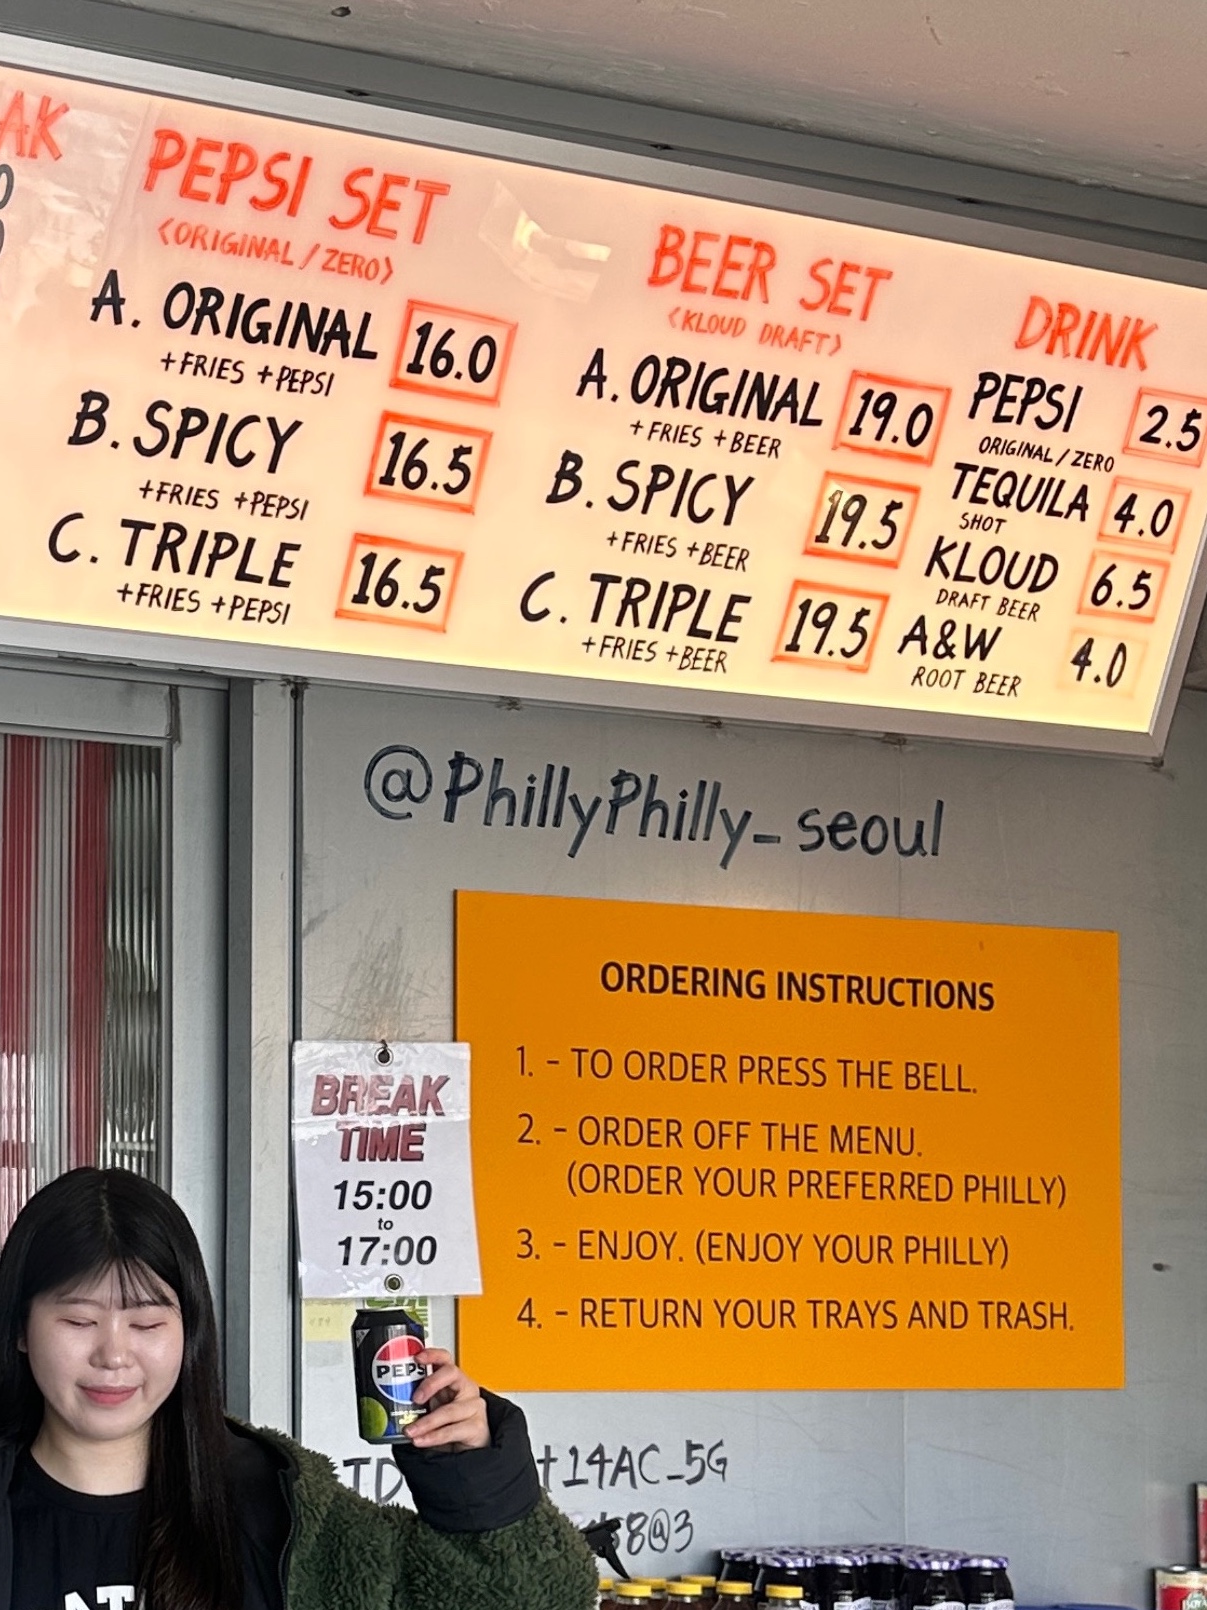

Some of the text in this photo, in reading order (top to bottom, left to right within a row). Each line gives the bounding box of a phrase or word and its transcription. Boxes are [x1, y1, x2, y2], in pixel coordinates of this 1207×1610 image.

[144, 128, 450, 245] PEPSI SET
[648, 224, 893, 322] BEER SET
[163, 282, 379, 361] ORIGINAL
[407, 321, 497, 385] 16.0
[1015, 296, 1158, 372] DRINK
[848, 388, 934, 447] 19.0
[969, 372, 1202, 453] PEPSI 2.5
[379, 431, 472, 496] 16.5
[608, 459, 755, 526] SPICY
[814, 489, 905, 550] 19.5
[953, 462, 1175, 539] TEQUILA 4.0
[960, 512, 1005, 535] SHOT
[120, 518, 301, 588] TRIPLE
[352, 551, 444, 615] 16.5
[926, 536, 1152, 610] KLOUD 6.5
[590, 573, 753, 644] TRIPLE
[784, 598, 871, 659] 19.5
[937, 588, 1041, 622] DRAFT BEER
[898, 616, 1129, 690] A&W 4.0
[912, 666, 1020, 698] ROOT BEER
[600, 961, 995, 1012] ORDERING INSTRUCTIONS
[311, 1074, 450, 1117] BREAK
[571, 1048, 614, 1082] TO
[623, 1050, 728, 1085] ORDER
[738, 1055, 828, 1089] PRESS
[838, 1059, 896, 1091] THE
[905, 1061, 977, 1094] BELL.
[337, 1122, 427, 1162] TIME
[578, 1115, 684, 1151] ORDER
[694, 1119, 754, 1151] OFF
[761, 1122, 819, 1154] THE
[829, 1124, 922, 1158] MENU.
[334, 1180, 433, 1211] 15:00
[567, 1161, 1067, 1209] (ORDER YOUR PREFERRED PHILLY)
[378, 1217, 394, 1231] to
[338, 1235, 438, 1267] 17:00
[578, 1230, 684, 1263] ENJOY.
[695, 1231, 801, 1267] (ENJOY
[811, 1233, 895, 1267] YOUR
[903, 1235, 1009, 1271] PHILLY)
[580, 1298, 703, 1330] RETURN
[713, 1299, 796, 1331] YOUR
[806, 1299, 898, 1331] TRAYS
[908, 1300, 970, 1331] AND
[977, 1300, 1076, 1332] TRASH.
